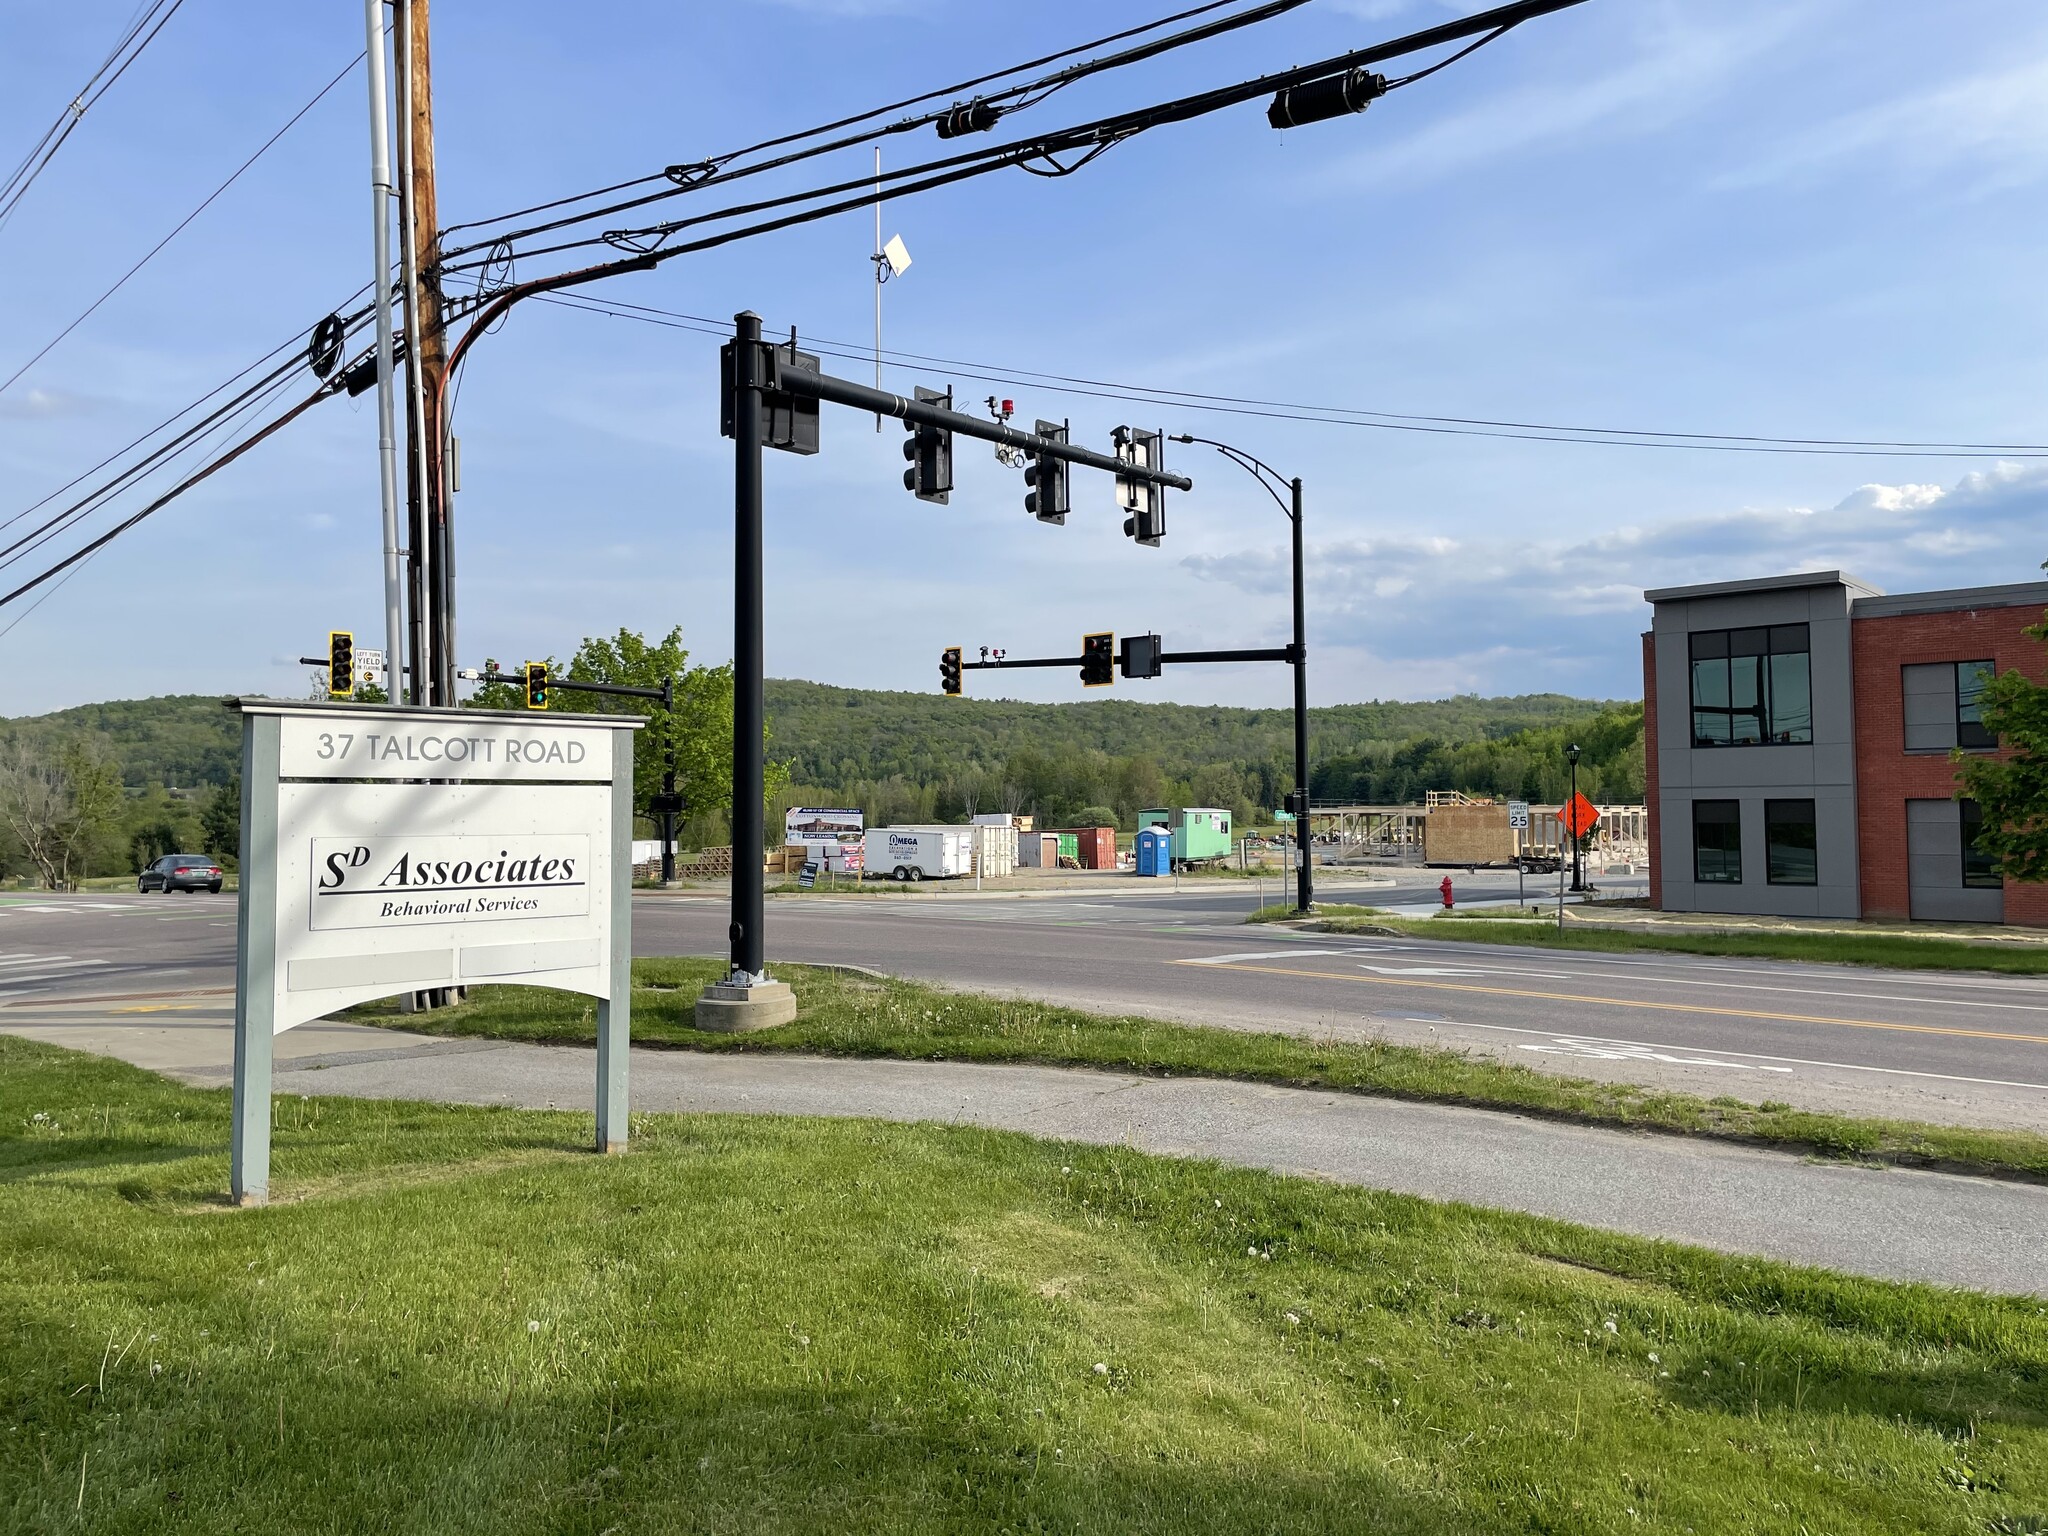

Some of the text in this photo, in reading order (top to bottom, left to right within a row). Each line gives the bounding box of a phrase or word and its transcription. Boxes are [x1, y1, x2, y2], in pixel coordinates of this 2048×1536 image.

[357, 657, 381, 666] YIELD
[316, 732, 586, 764] 37 TALCOTT ROAD
[1511, 816, 1527, 826] 25
[377, 849, 576, 887] Associates
[380, 896, 539, 918] Behavioral Services
